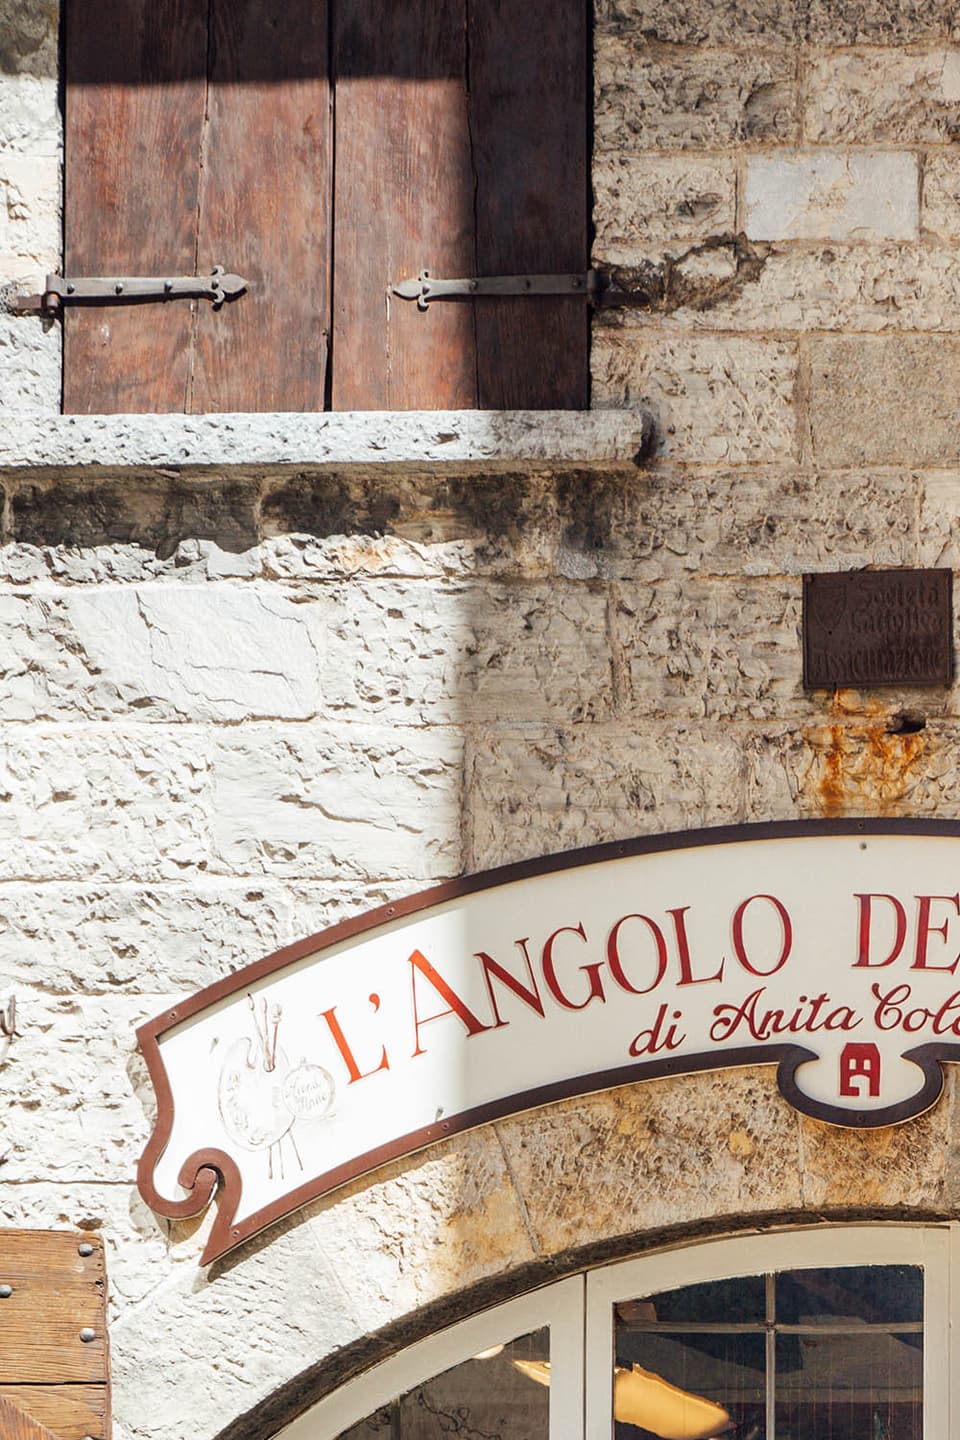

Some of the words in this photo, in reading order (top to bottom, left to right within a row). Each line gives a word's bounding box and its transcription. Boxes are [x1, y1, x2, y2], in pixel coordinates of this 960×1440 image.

[318, 894, 794, 1086] L'ANGOLO
[628, 1003, 686, 1057] di
[710, 986, 863, 1041] Anita
